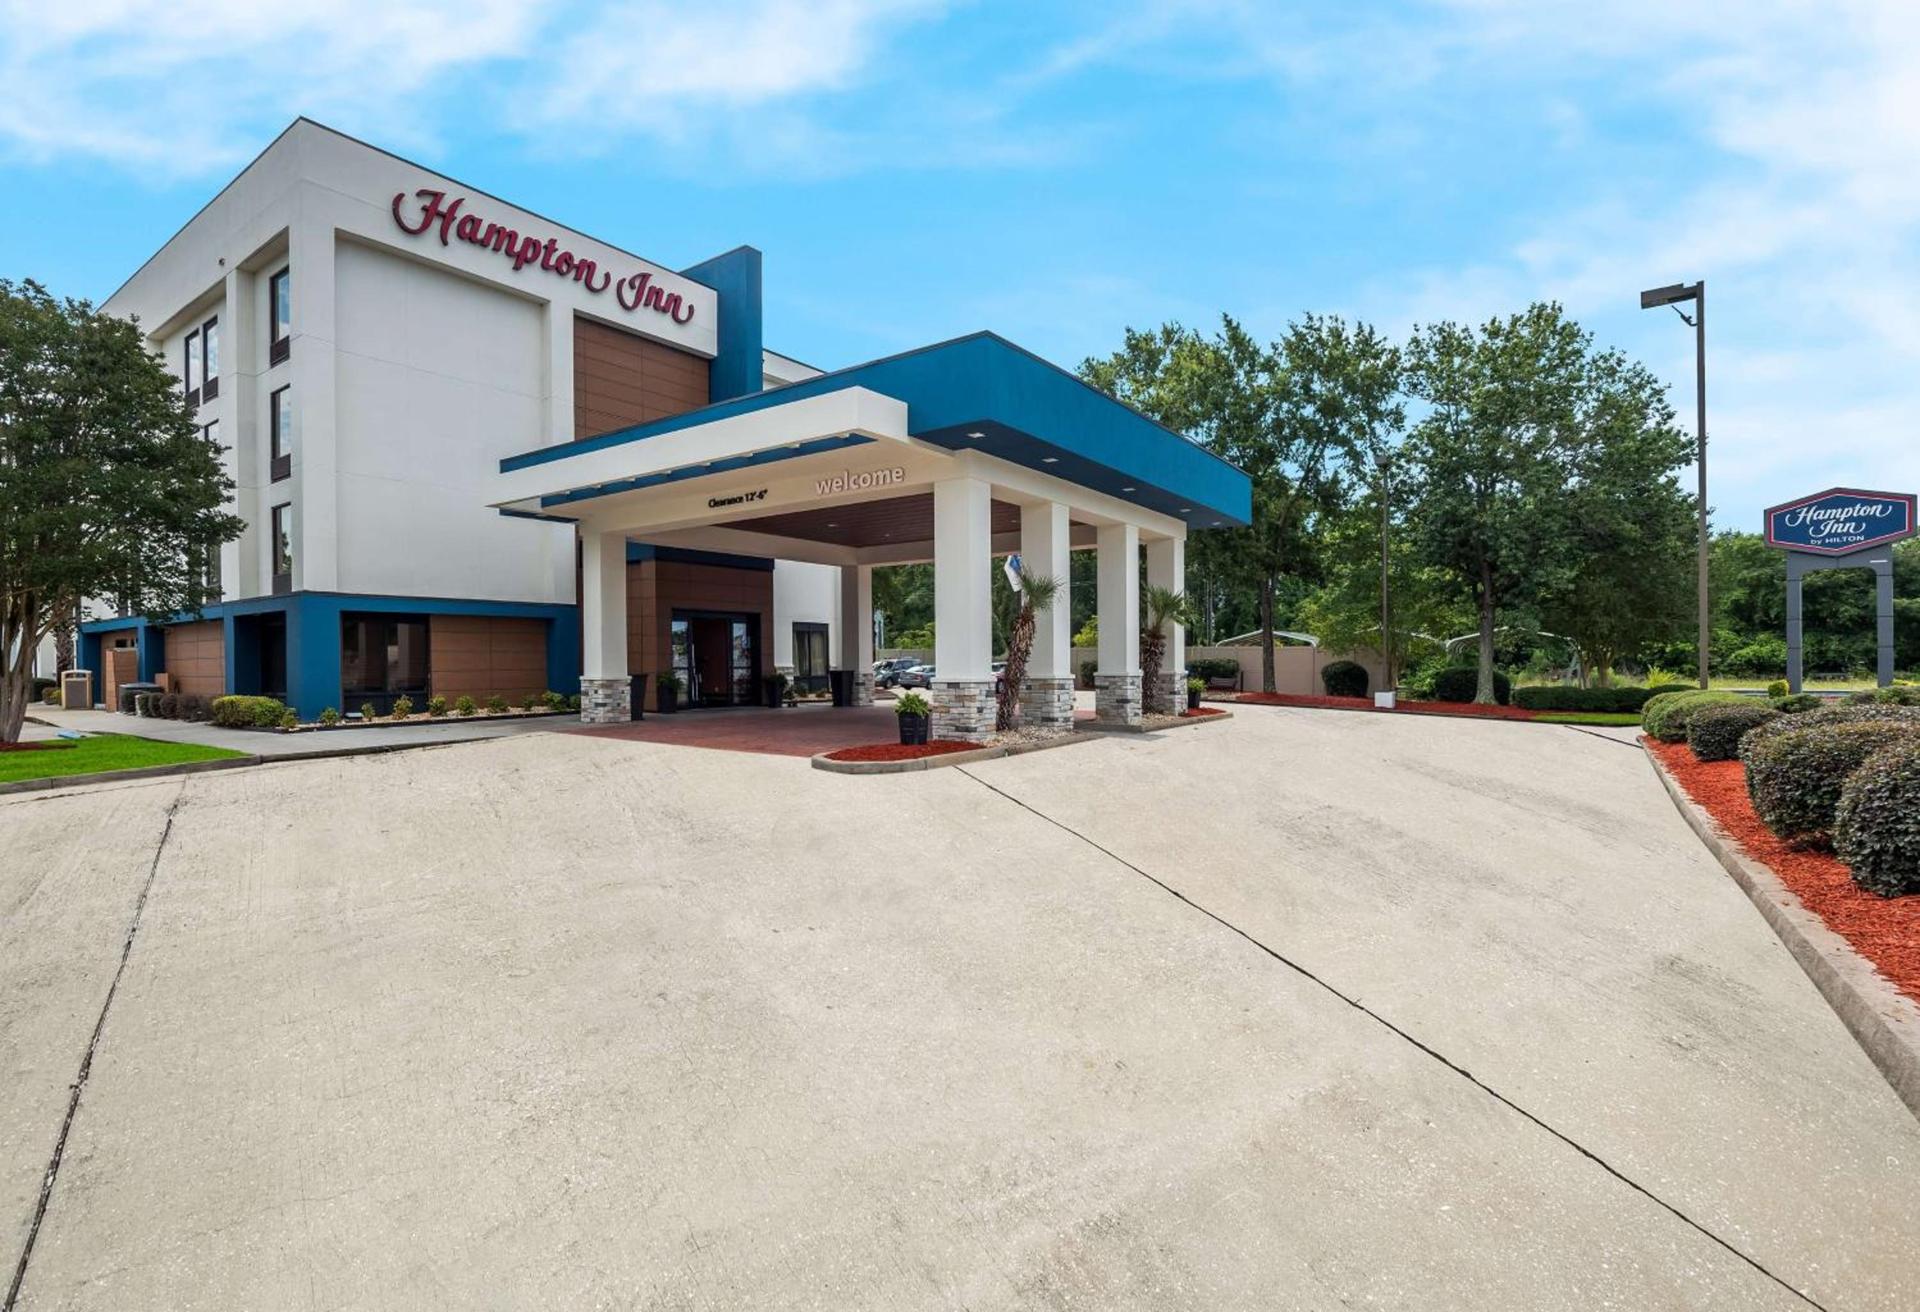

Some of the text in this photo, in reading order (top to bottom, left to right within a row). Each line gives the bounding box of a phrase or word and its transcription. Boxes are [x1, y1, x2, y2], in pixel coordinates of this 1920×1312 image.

[392, 189, 694, 325] Hampton Inn
[816, 467, 905, 496] welcome
[708, 496, 744, 508] Clearance
[1785, 503, 1893, 527] Hampton
[1809, 520, 1866, 538] Inn
[1825, 534, 1865, 544] HILTON
